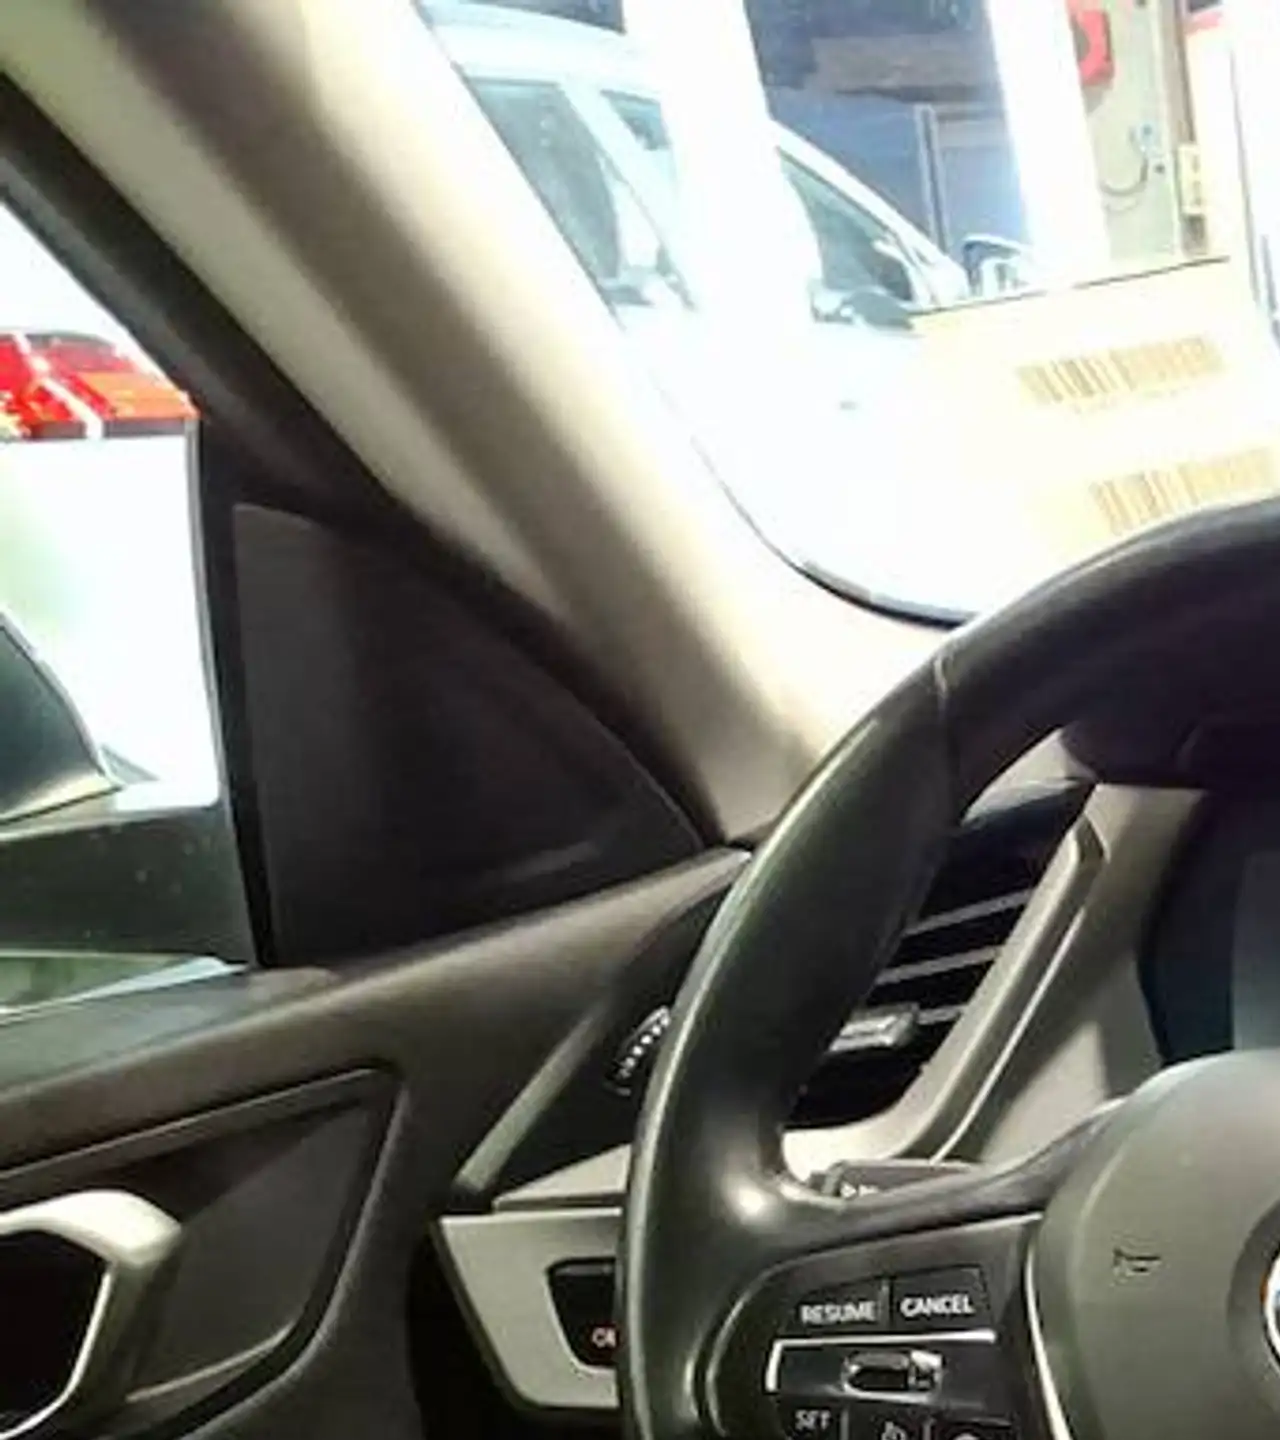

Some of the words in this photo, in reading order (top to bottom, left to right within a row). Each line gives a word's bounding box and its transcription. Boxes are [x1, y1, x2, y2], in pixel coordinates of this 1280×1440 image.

[800, 1300, 877, 1325] RESUME
[899, 1293, 976, 1317] CANCEL
[794, 1409, 832, 1431] SET
